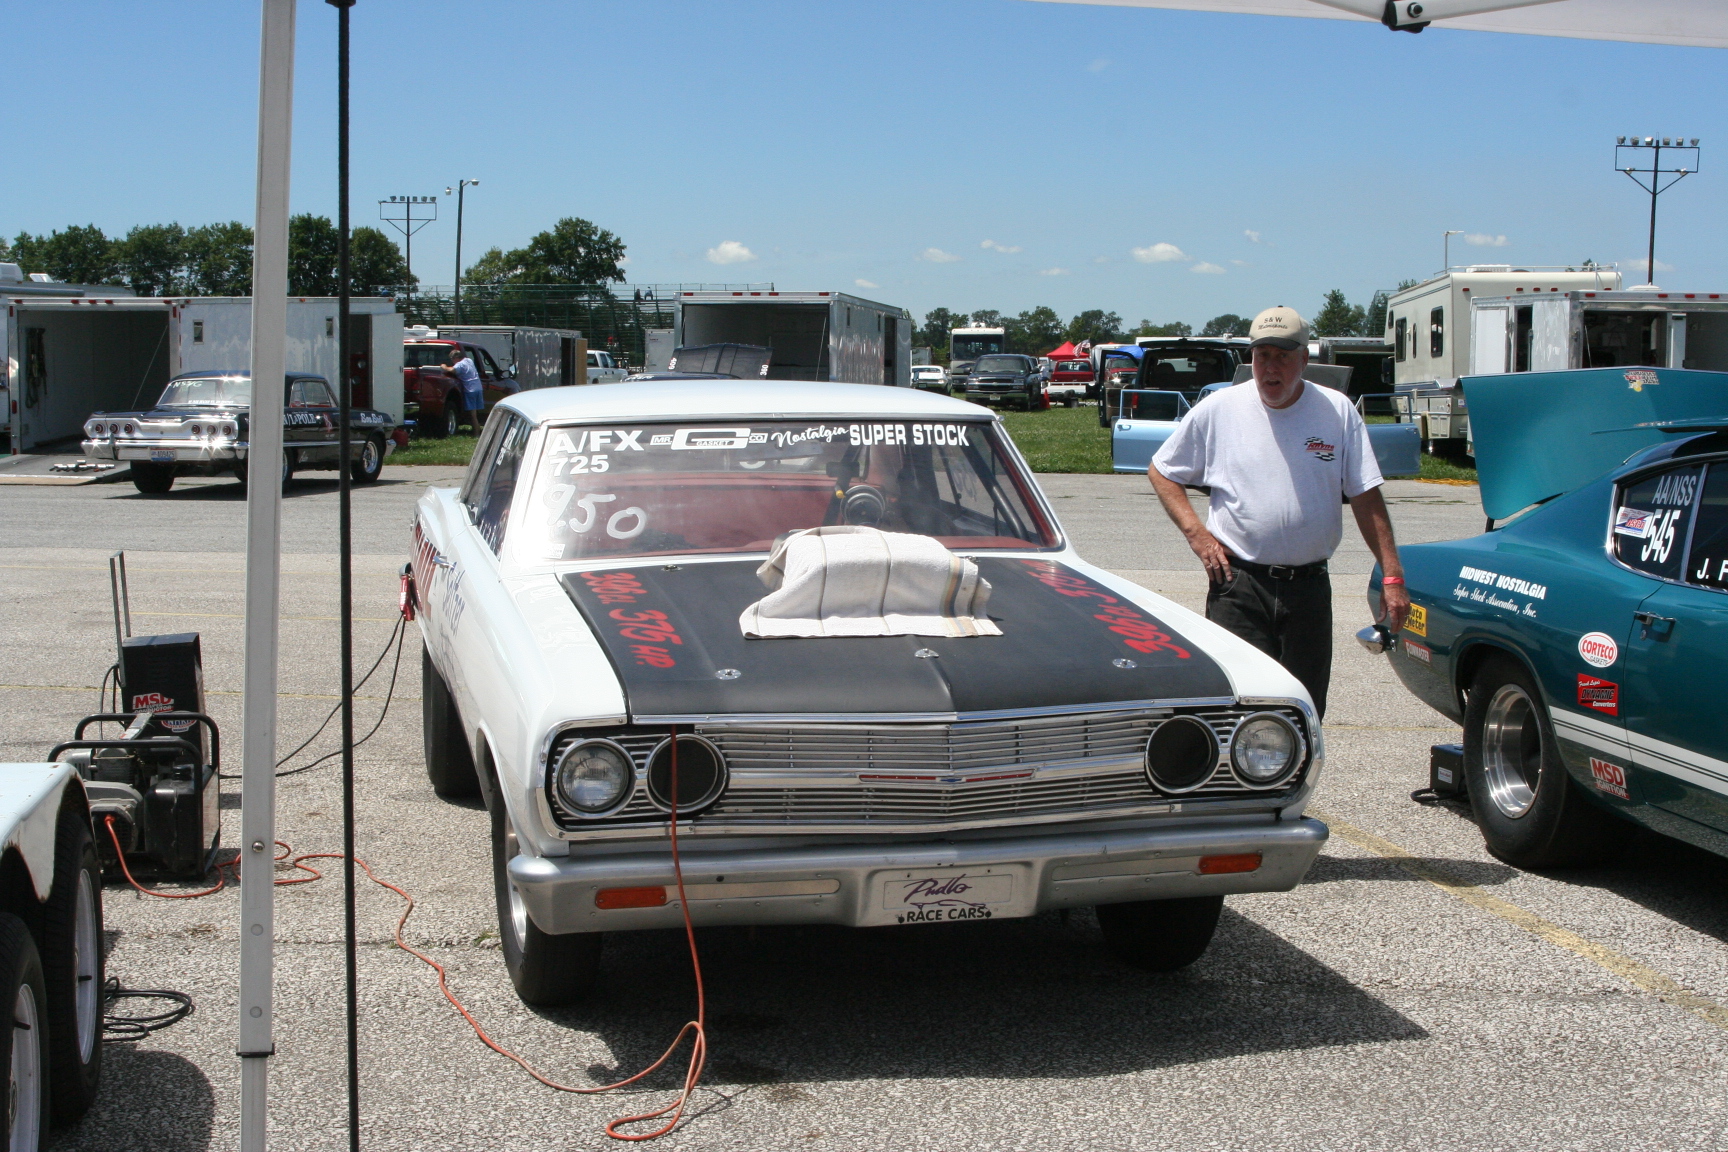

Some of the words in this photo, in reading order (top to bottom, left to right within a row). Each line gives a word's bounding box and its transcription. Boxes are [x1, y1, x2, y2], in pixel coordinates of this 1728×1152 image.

[550, 430, 645, 455] A/FX
[771, 425, 849, 448] Nostalgia
[850, 424, 906, 446] SUPER
[913, 424, 969, 447] STOCK
[550, 454, 610, 477] 725
[1652, 475, 1696, 506] AA/NSS
[1641, 509, 1681, 563] 545
[1696, 558, 1710, 579] J.
[1459, 565, 1497, 586] MIDWEST
[1496, 574, 1547, 600] NOSTALGIA
[1453, 583, 1469, 601] Super
[1470, 587, 1487, 603] Stock
[1485, 593, 1520, 615] Association,
[1522, 602, 1537, 618] Inc.
[608, 608, 683, 645] 375
[1093, 614, 1192, 660] 396
[1582, 639, 1615, 660] CORTECO
[134, 693, 172, 708] MSD
[1581, 687, 1615, 700] DYNAMIC
[1592, 700, 1616, 708] Converters
[1591, 758, 1624, 786] MSD
[1596, 778, 1627, 798] IGNITION
[906, 909, 943, 922] RACE
[948, 907, 985, 920] CARS
